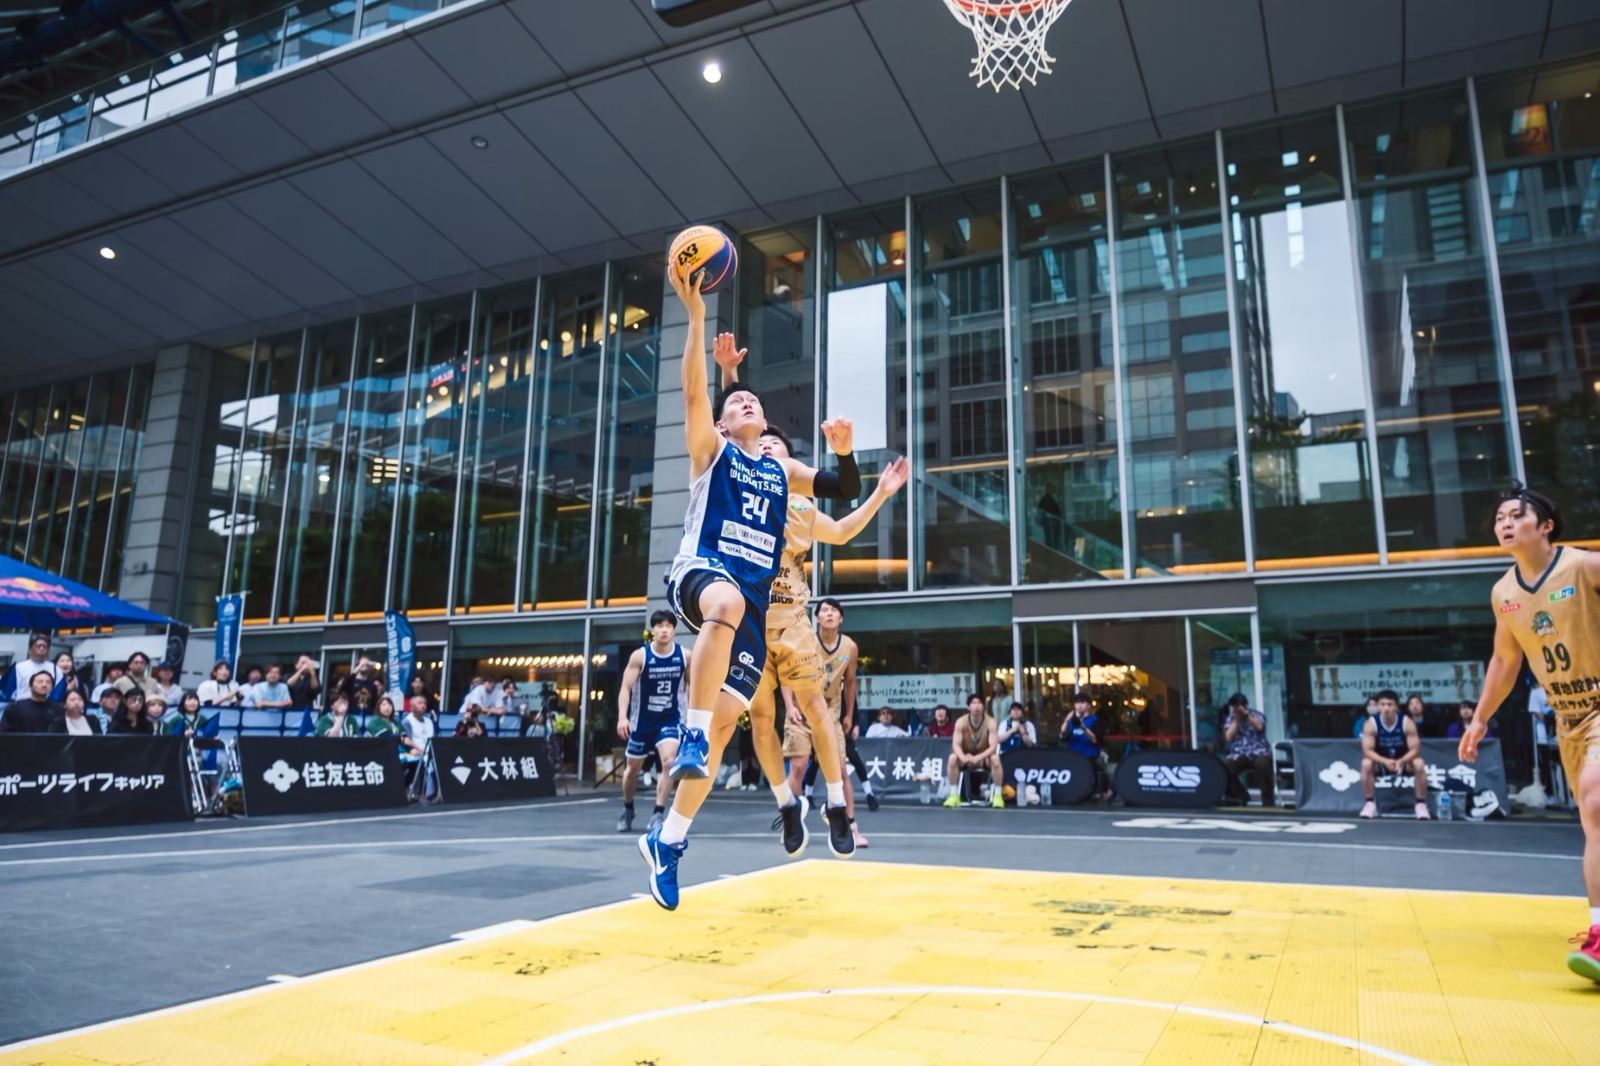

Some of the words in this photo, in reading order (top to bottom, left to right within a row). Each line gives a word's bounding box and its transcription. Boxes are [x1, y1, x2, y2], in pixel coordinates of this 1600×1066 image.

[741, 491, 770, 525] 24
[1542, 643, 1572, 673] 99
[656, 680, 672, 694] 23
[301, 761, 385, 788] 住友生命
[477, 756, 540, 782] 大林組
[865, 756, 943, 781] 大林組
